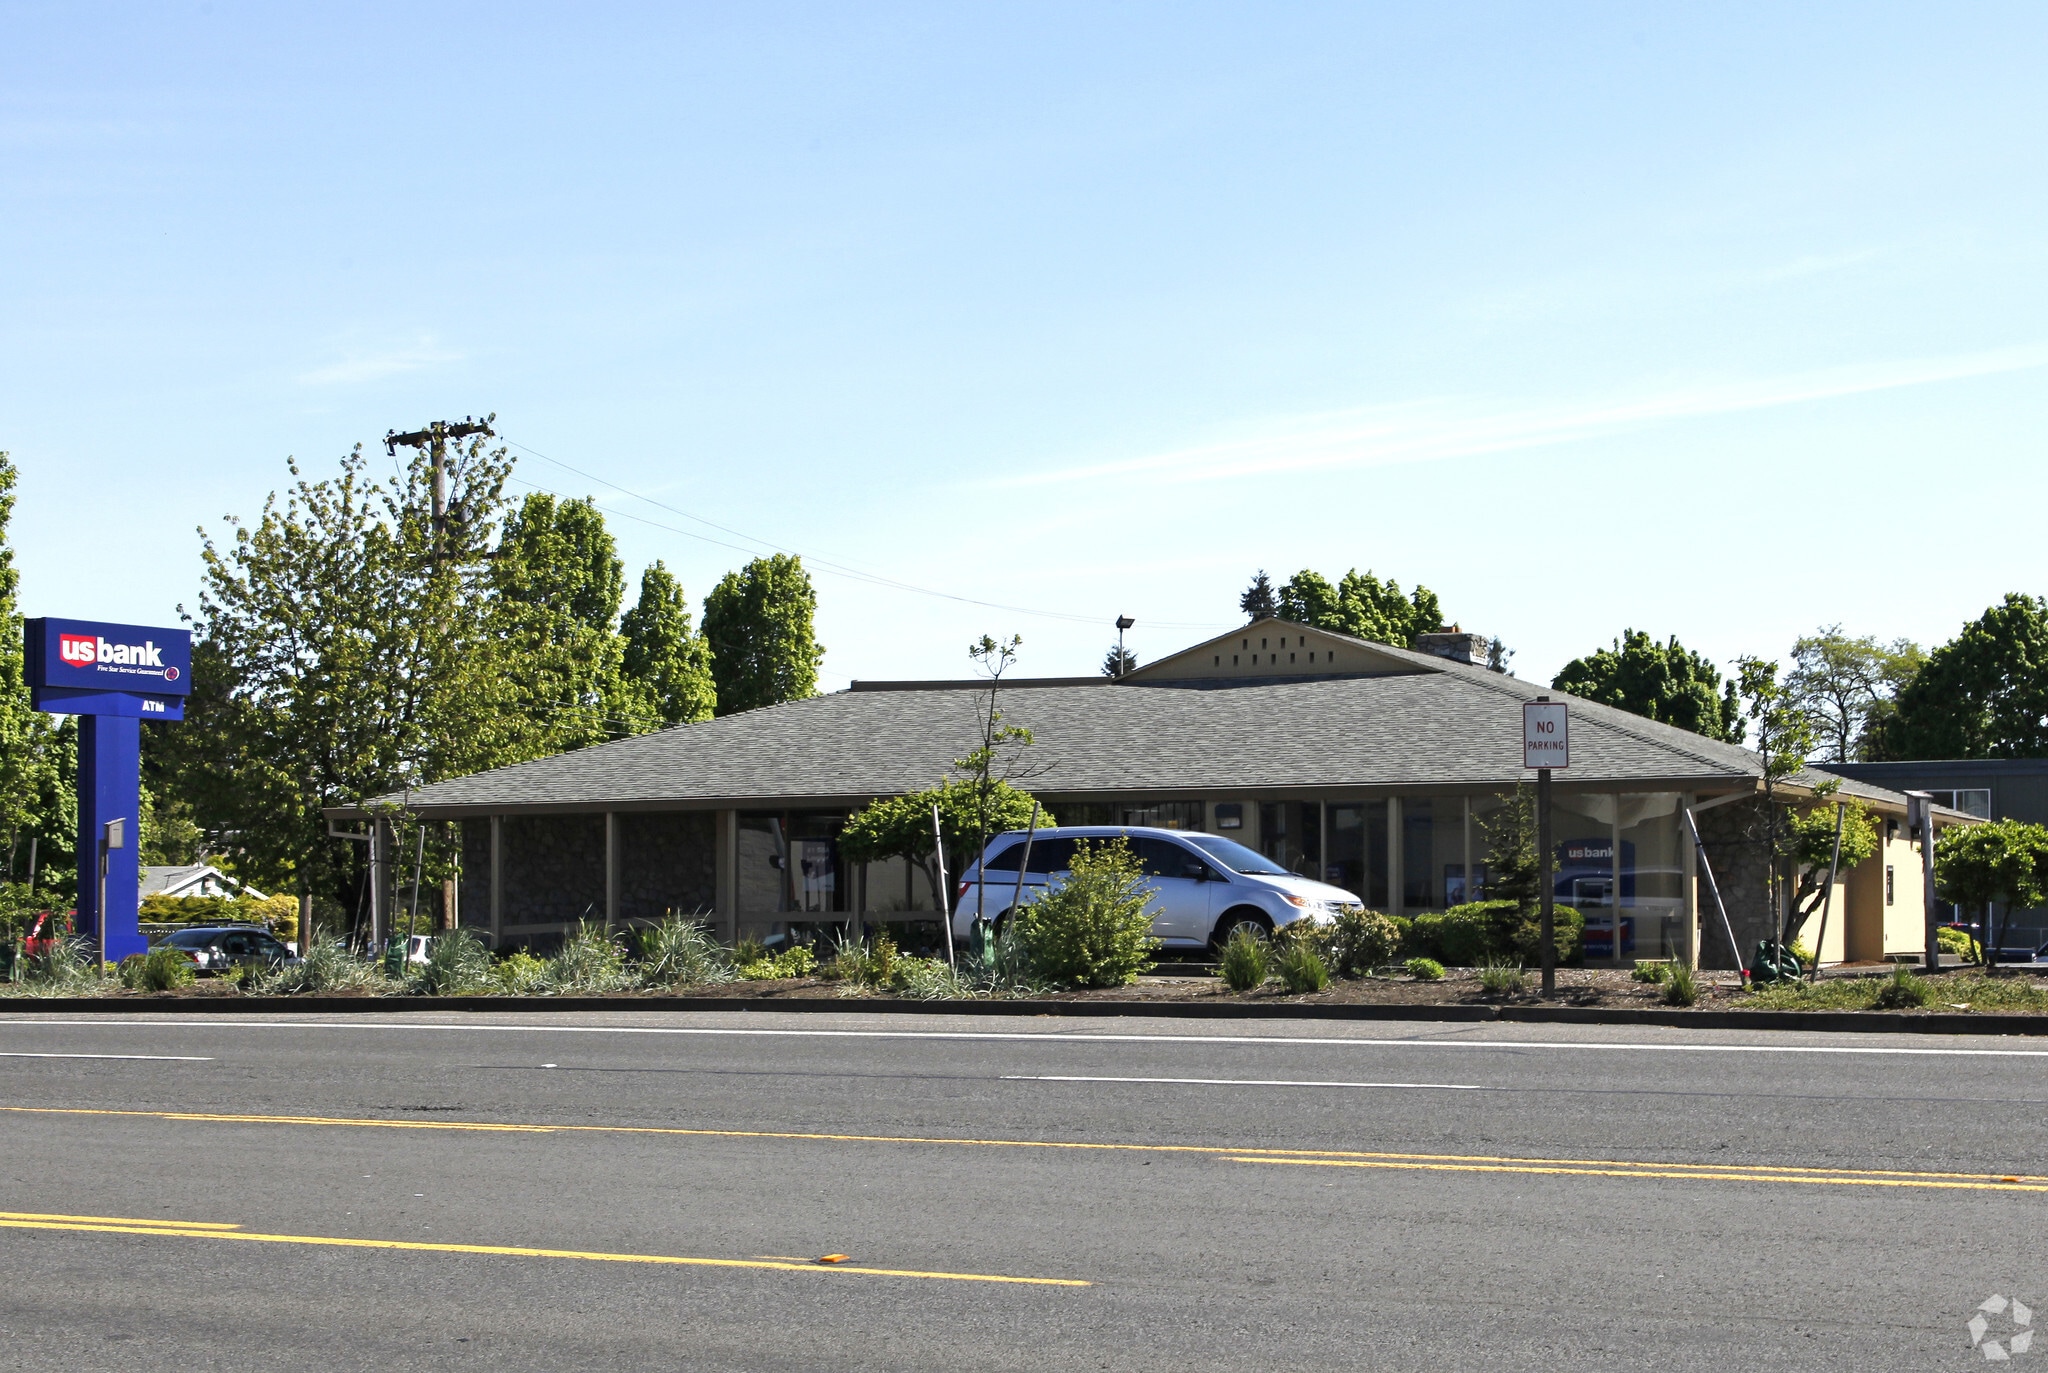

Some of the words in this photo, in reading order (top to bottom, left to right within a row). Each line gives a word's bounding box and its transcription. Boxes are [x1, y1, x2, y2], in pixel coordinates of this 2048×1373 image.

[142, 700, 165, 712] ATM
[1537, 721, 1554, 733] NO
[1528, 741, 1564, 751] PARKING
